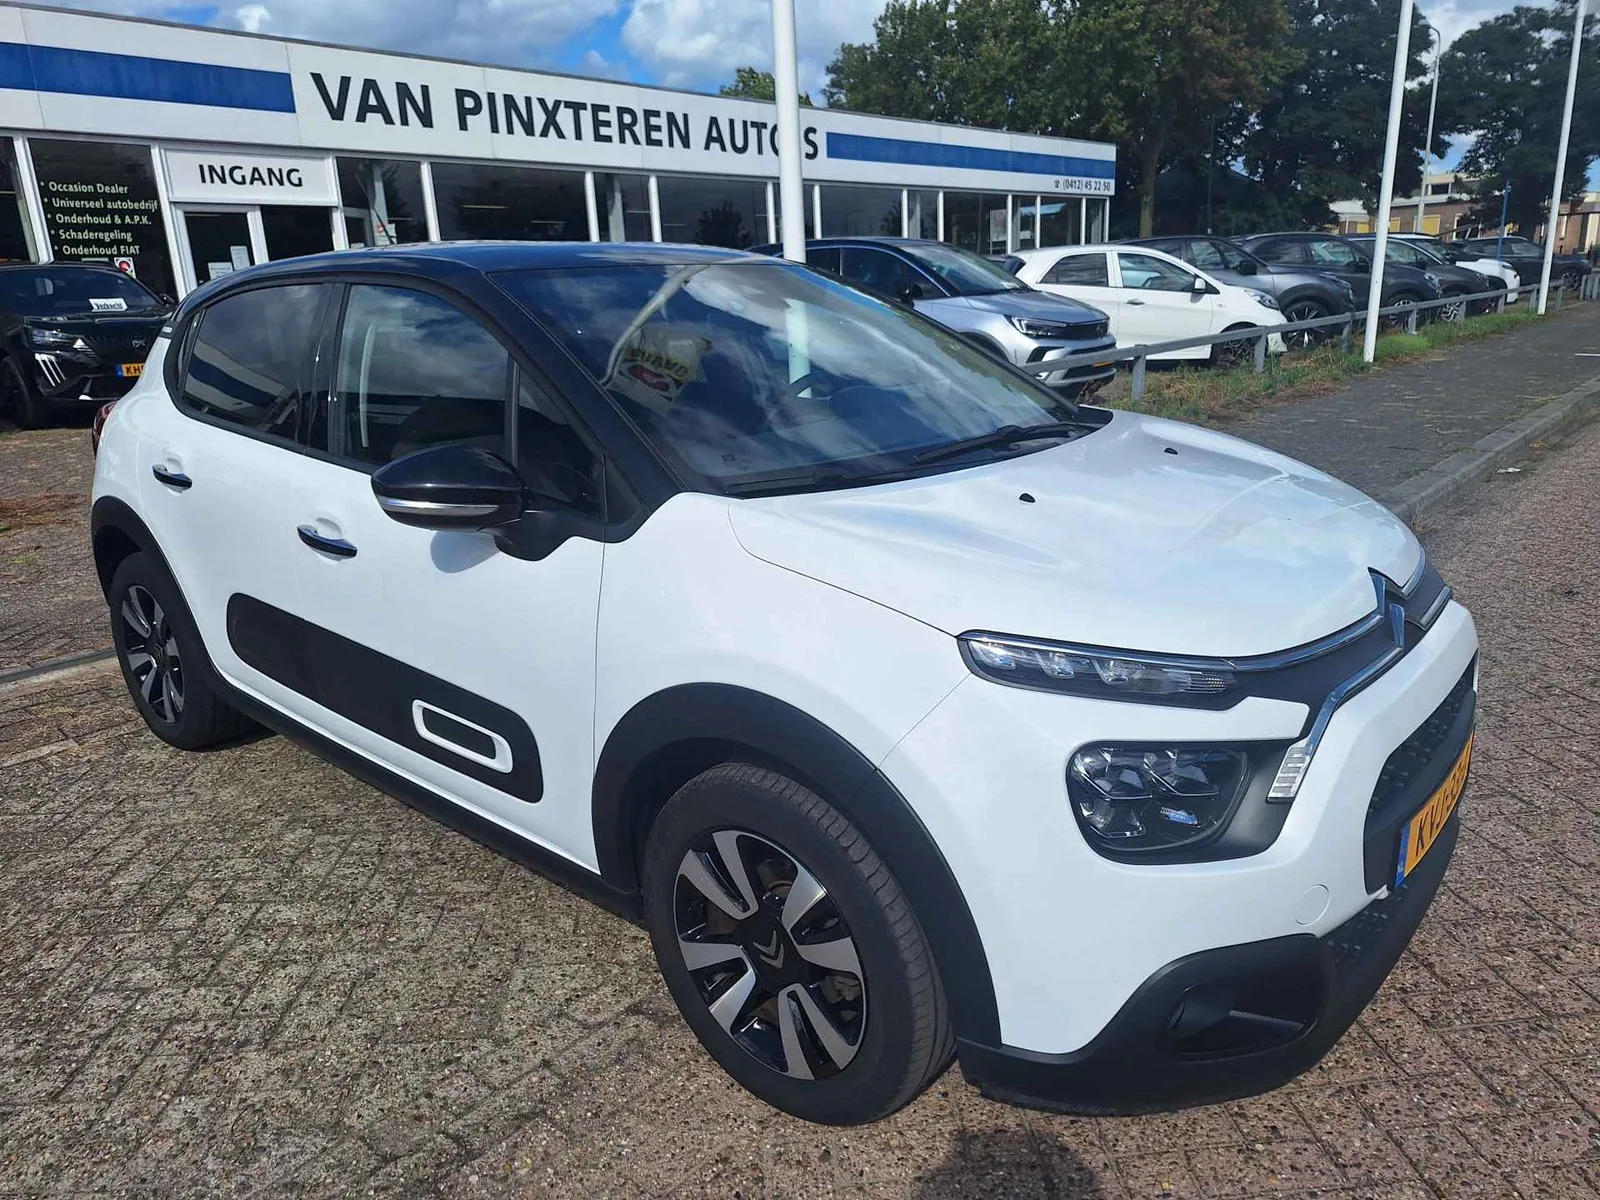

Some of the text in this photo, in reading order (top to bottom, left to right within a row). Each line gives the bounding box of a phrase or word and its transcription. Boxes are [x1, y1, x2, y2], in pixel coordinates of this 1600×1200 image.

[310, 72, 433, 129] VAN
[455, 88, 691, 149] PINXTEREN
[198, 163, 303, 188] INGANG
[48, 181, 128, 194] Occasion Dealer
[52, 197, 158, 213] Universeel autobedrijf
[55, 213, 152, 225] Onderhoud & A.P.K.
[59, 229, 133, 243] Schaderegeling
[62, 245, 140, 256] Onderhoud FIAT
[125, 364, 145, 376] KH
